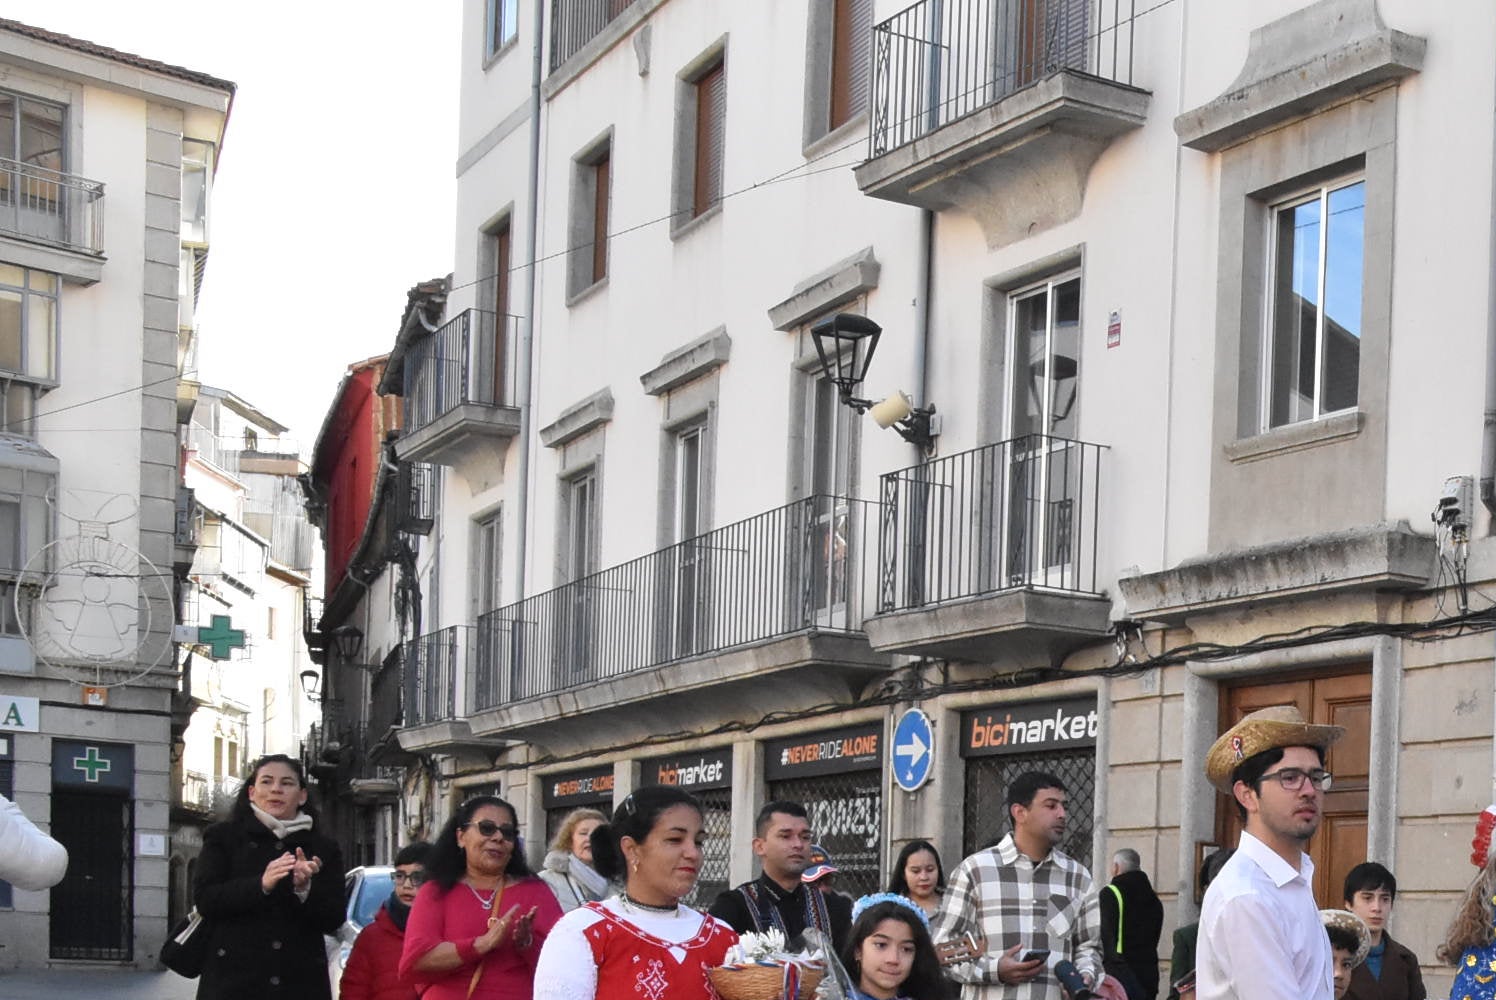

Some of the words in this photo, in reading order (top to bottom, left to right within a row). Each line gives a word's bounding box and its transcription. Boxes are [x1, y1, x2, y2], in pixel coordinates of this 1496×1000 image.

[3, 702, 24, 727] A
[970, 708, 1098, 749] bicimarket
[781, 735, 878, 766] #NEVERRIDEALONE
